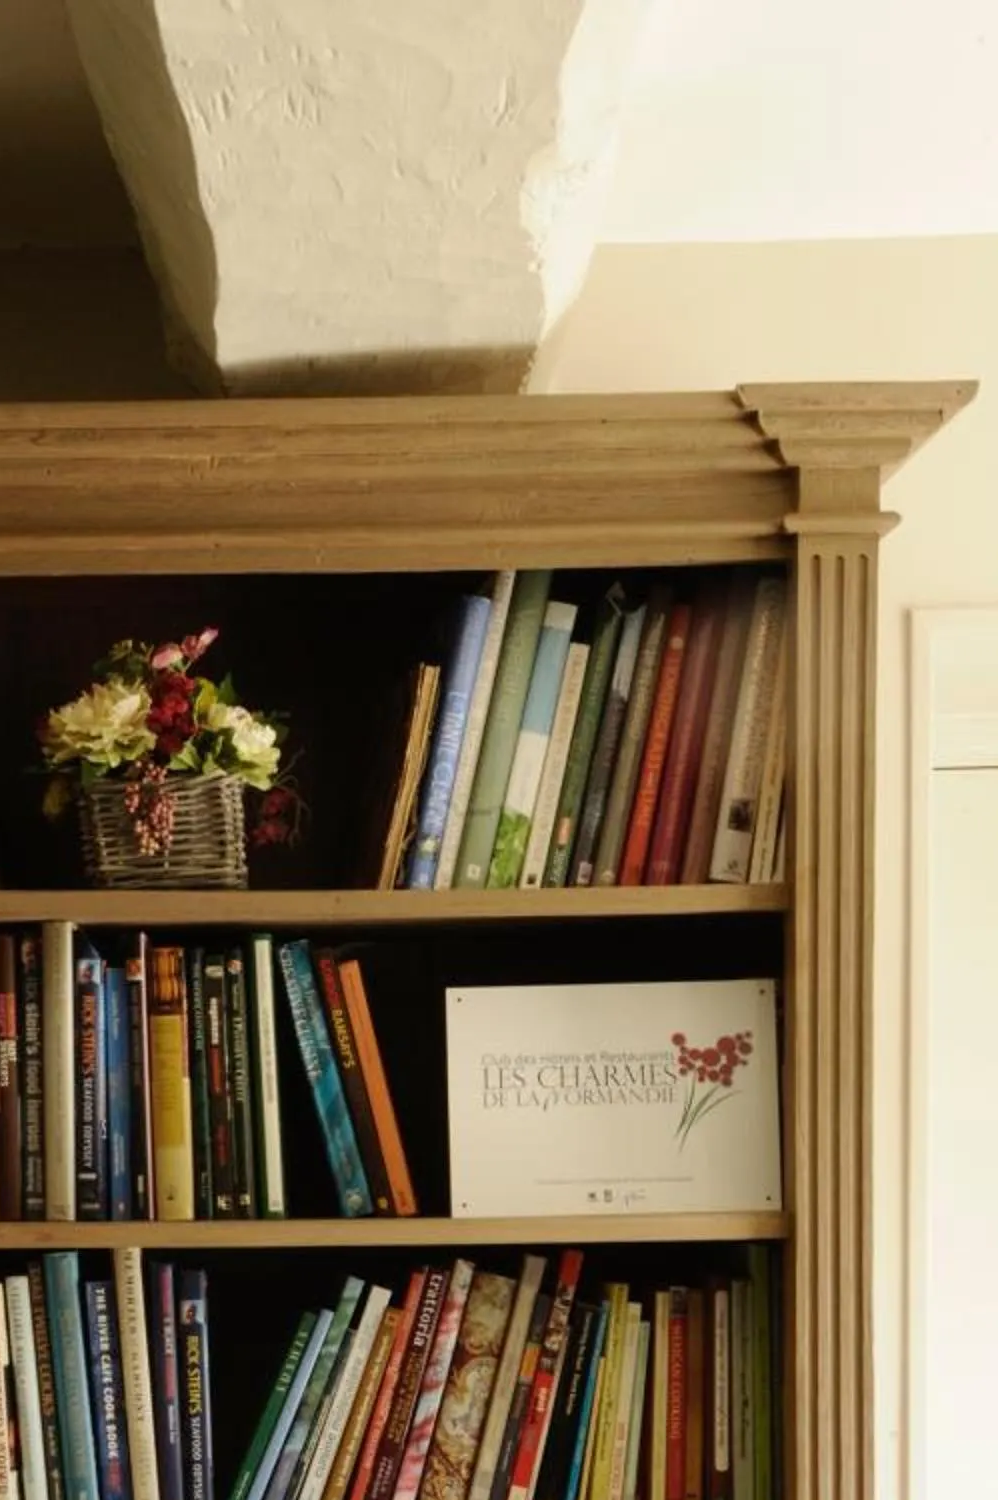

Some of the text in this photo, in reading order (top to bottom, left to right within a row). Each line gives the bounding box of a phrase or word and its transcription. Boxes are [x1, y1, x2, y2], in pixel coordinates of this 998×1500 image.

[24, 1001, 41, 1054] stein's
[25, 1059, 41, 1093] food
[483, 1063, 678, 1089] LES CHARMES
[483, 1090, 504, 1108] DE
[516, 1089, 540, 1107] LA
[26, 1098, 42, 1151] heroes
[93, 1286, 107, 1310] THE
[412, 1271, 444, 1348] trattoria
[96, 1313, 110, 1350] RIVER
[186, 1334, 200, 1364] RICK
[102, 1386, 116, 1421] COOK
[187, 1367, 202, 1414] STEIN'S
[105, 1423, 119, 1458] BOOK
[190, 1416, 202, 1459] SEAFOOD
